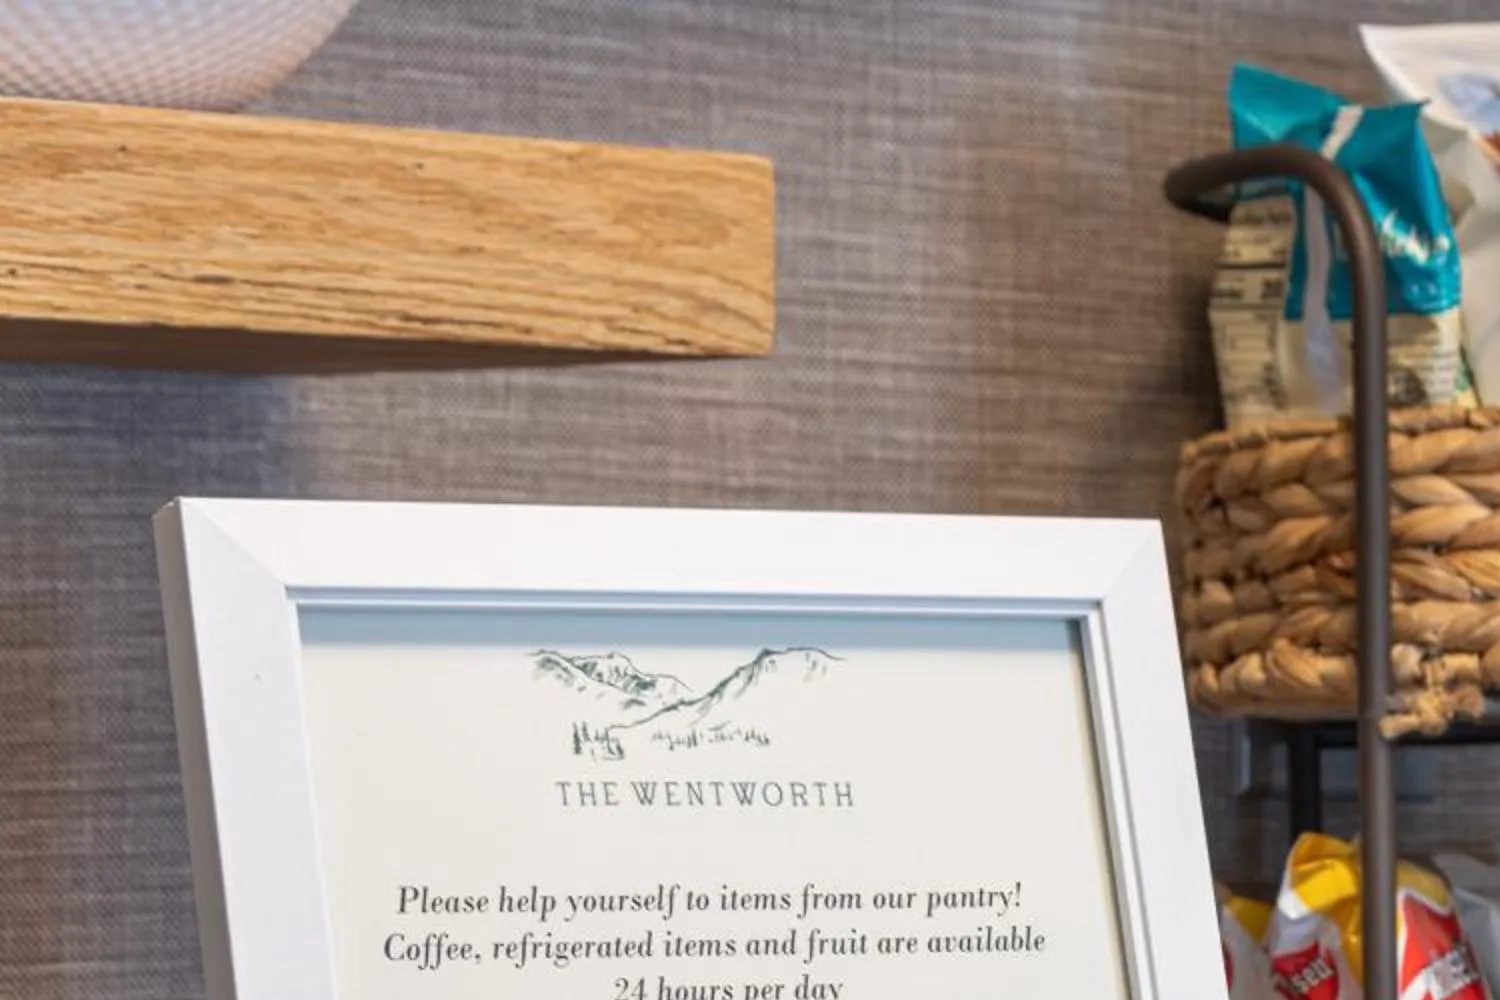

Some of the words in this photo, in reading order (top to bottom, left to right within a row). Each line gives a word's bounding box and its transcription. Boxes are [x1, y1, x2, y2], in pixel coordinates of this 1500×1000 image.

[556, 782, 618, 806] THE
[630, 782, 853, 807] WENTWORTH
[398, 886, 488, 914] Please
[499, 885, 556, 922] help
[564, 884, 680, 922] yourself
[687, 891, 710, 911] to
[721, 884, 791, 911] items
[797, 883, 862, 919] from
[873, 892, 917, 909] our
[927, 881, 1021, 918] pantry!
[384, 932, 481, 971] Coffee,
[493, 930, 652, 969] refrigerated
[664, 931, 736, 957] items
[746, 929, 796, 955] and
[803, 928, 866, 964] fruit
[877, 937, 918, 954] are
[927, 925, 1045, 952] available
